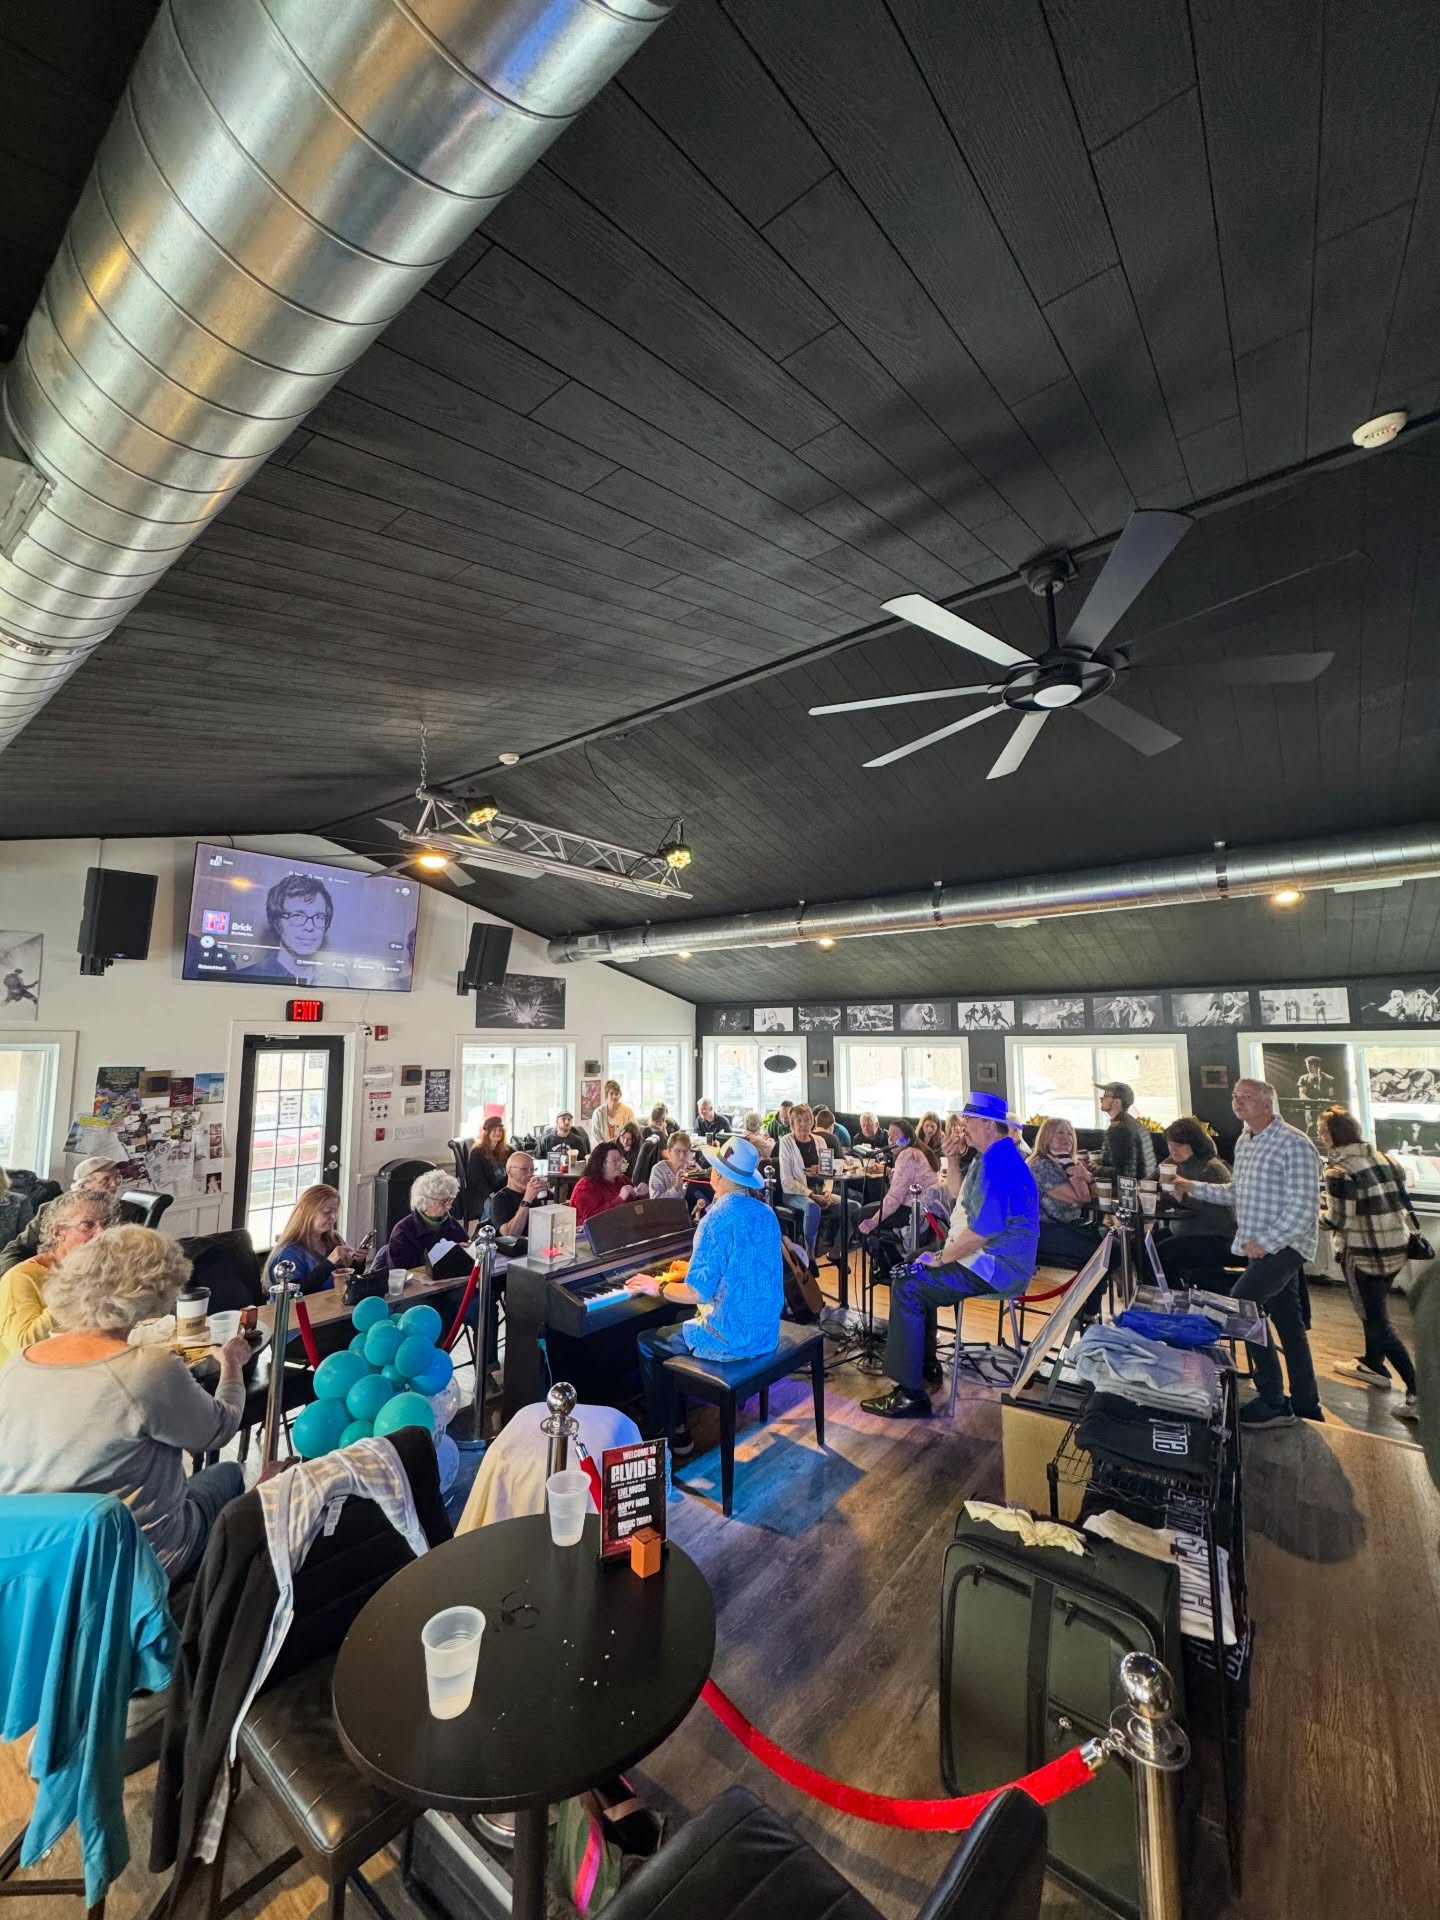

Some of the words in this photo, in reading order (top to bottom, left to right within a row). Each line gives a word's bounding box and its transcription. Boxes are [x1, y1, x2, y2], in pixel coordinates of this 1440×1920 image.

[231, 922, 253, 932] Brick
[293, 1001, 320, 1020] EXIT
[623, 1447, 649, 1460] WELCOME
[649, 1446, 656, 1455] TO
[618, 1486, 629, 1497] LIVE
[629, 1483, 646, 1495] MUSIC
[618, 1500, 635, 1511] HAPPY
[635, 1497, 650, 1508] HOUR
[618, 1519, 635, 1530] MUSIC
